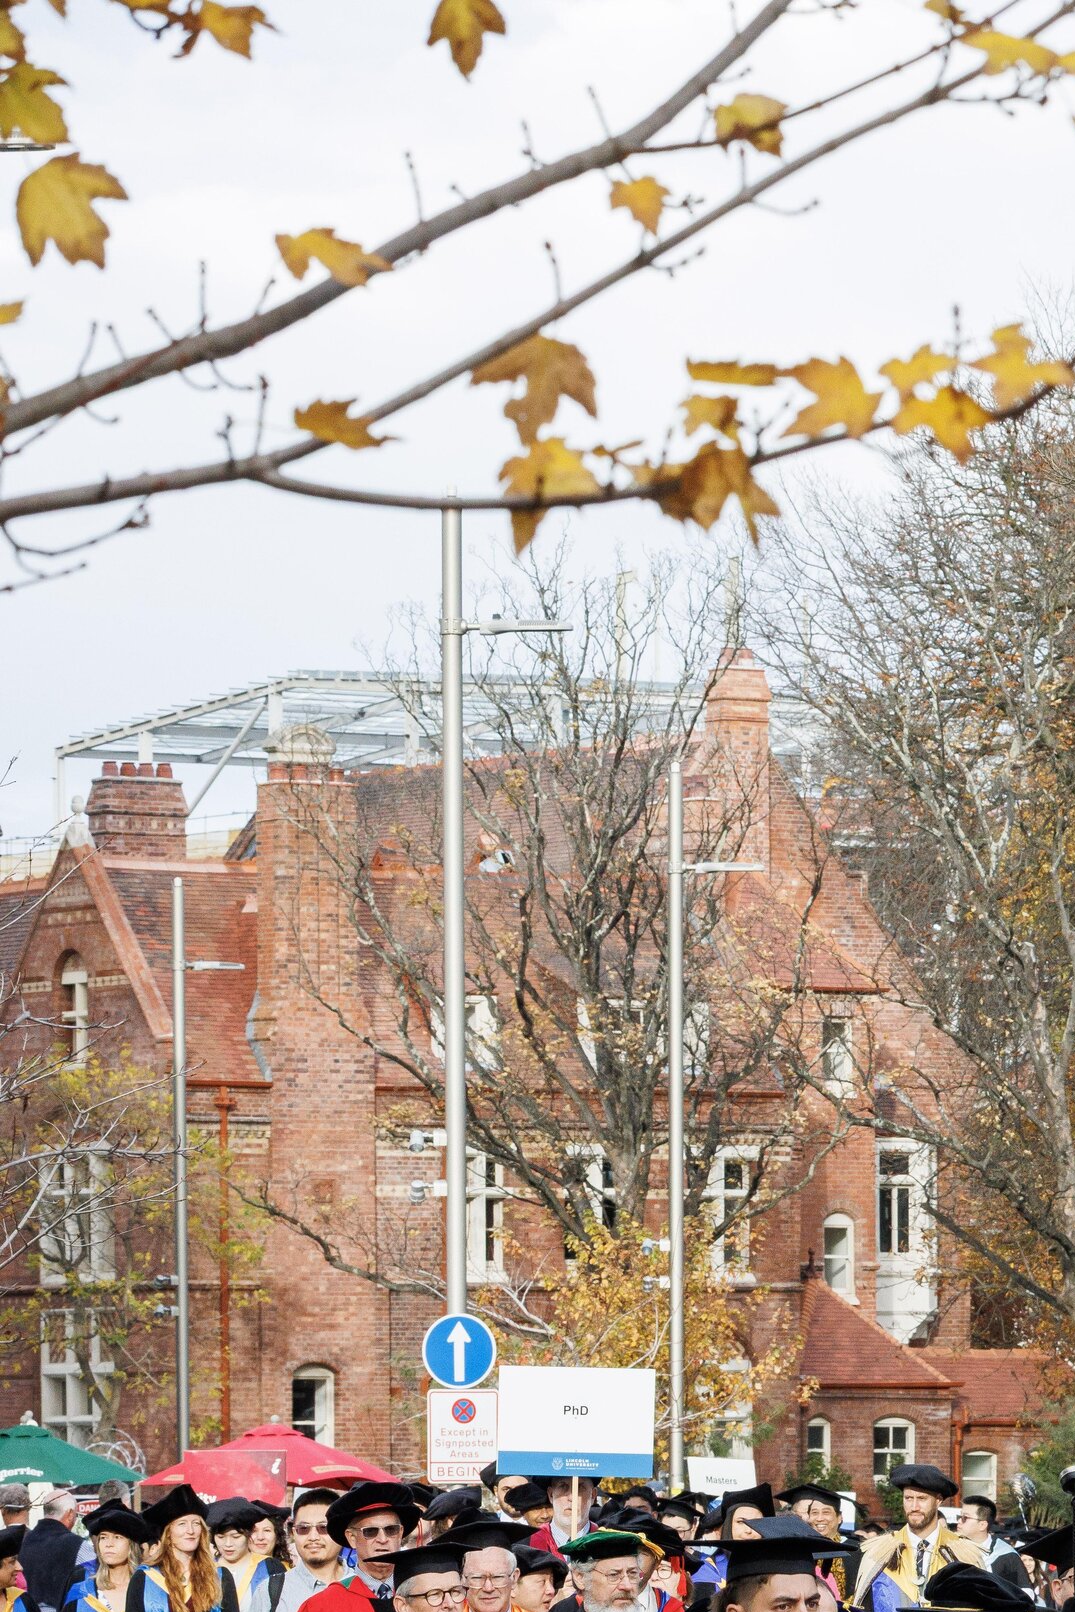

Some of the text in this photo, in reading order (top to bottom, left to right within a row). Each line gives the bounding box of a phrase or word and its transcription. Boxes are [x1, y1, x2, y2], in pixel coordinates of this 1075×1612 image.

[563, 1404, 589, 1416] PhD
[440, 1427, 489, 1438] Except in
[435, 1438, 494, 1448] Signposted
[449, 1450, 480, 1458] Areas
[437, 1466, 482, 1477] BEGIN
[705, 1476, 738, 1485] Masters
